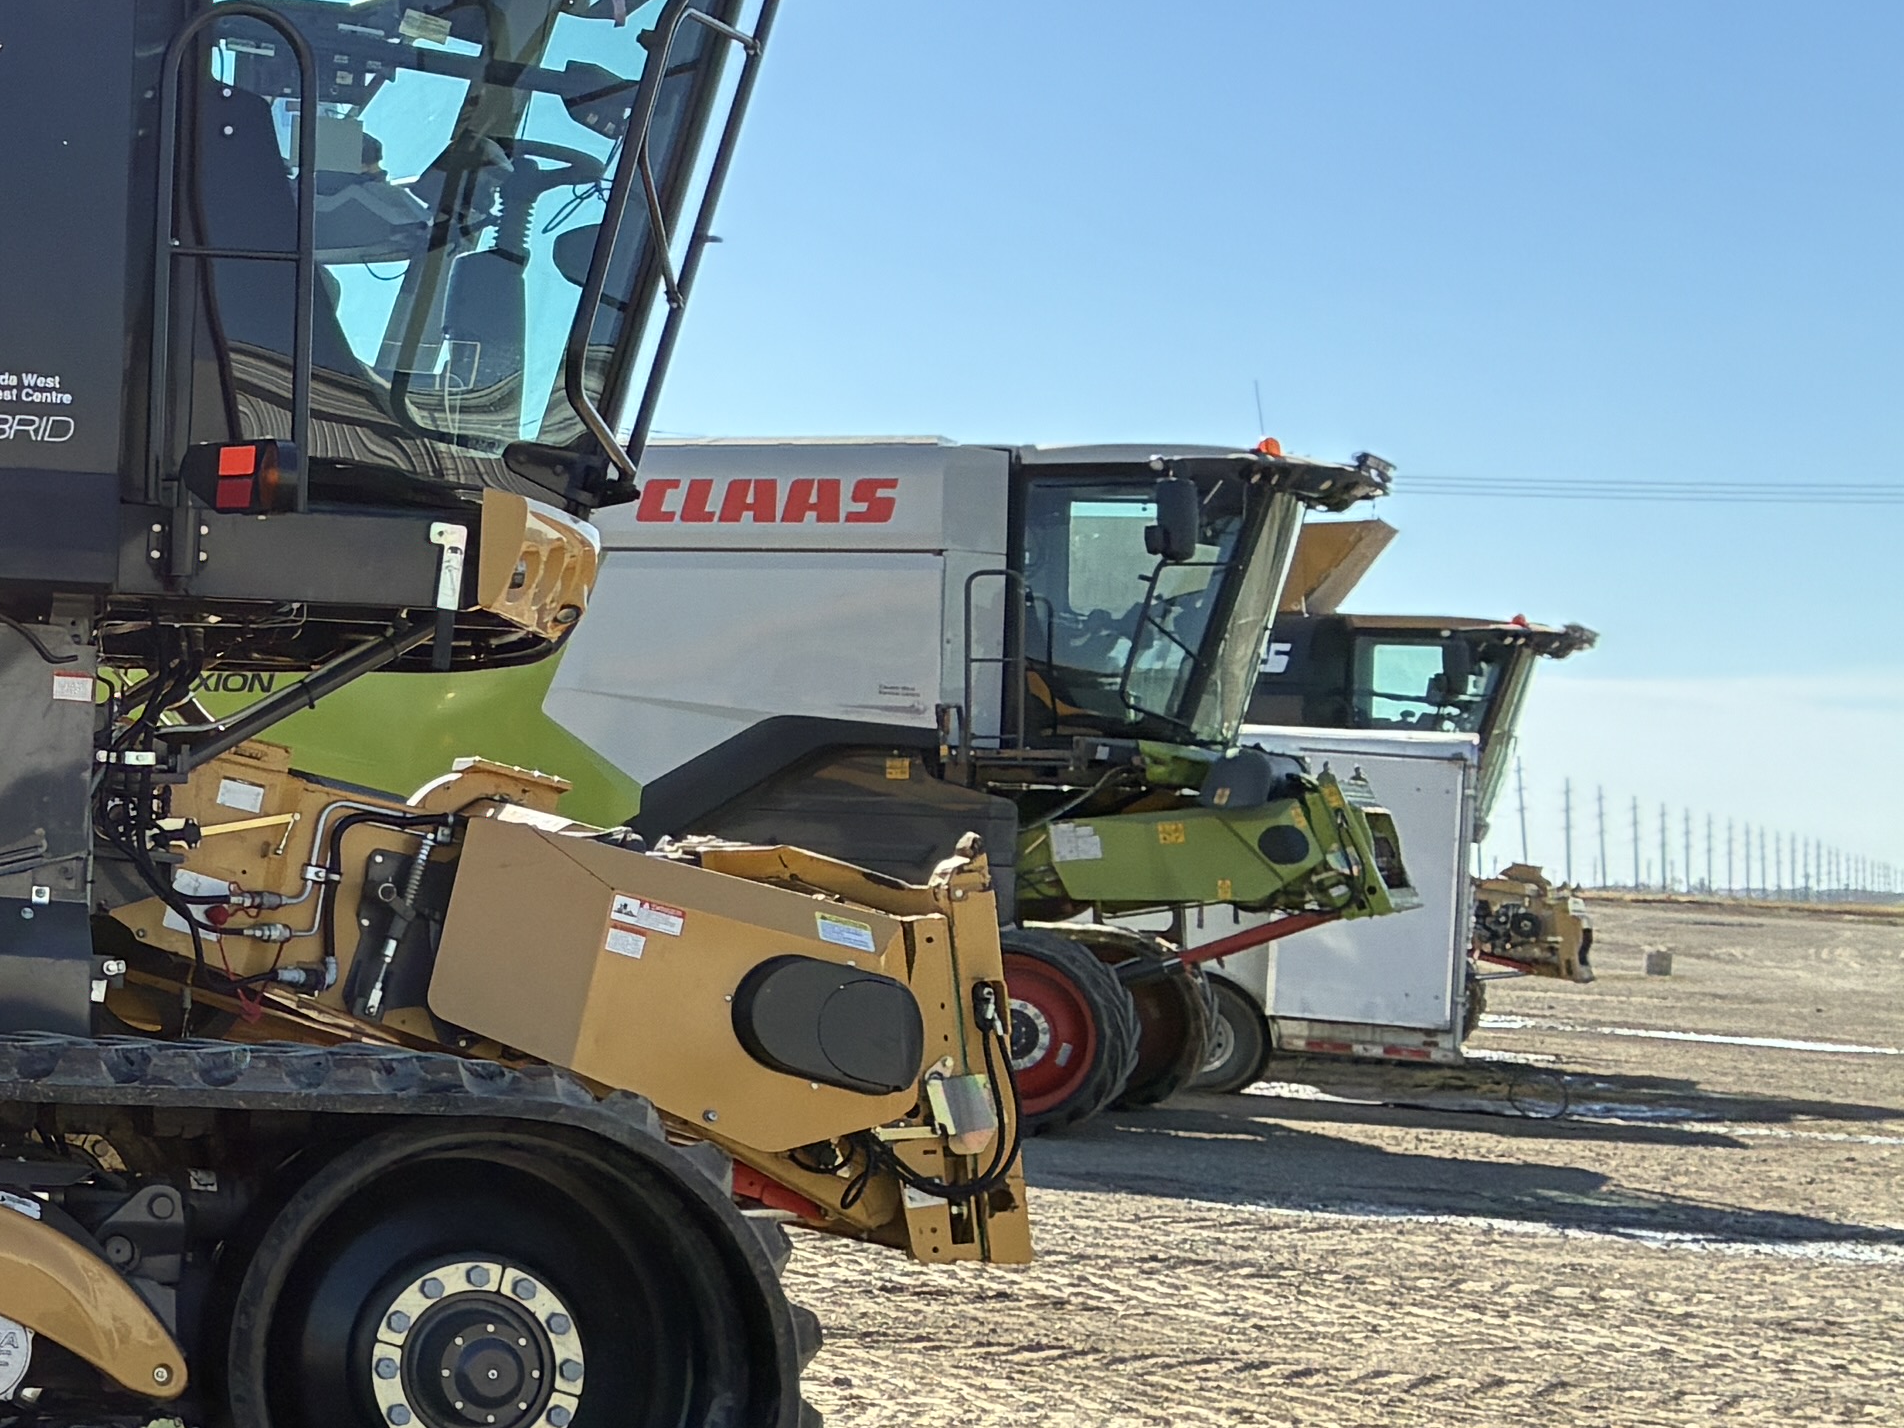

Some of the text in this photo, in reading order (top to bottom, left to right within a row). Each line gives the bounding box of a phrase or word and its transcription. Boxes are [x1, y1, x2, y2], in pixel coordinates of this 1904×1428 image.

[21, 372, 61, 388] West
[20, 387, 73, 405] Centre
[635, 478, 899, 523] CLAAS
[192, 673, 275, 693] XION
